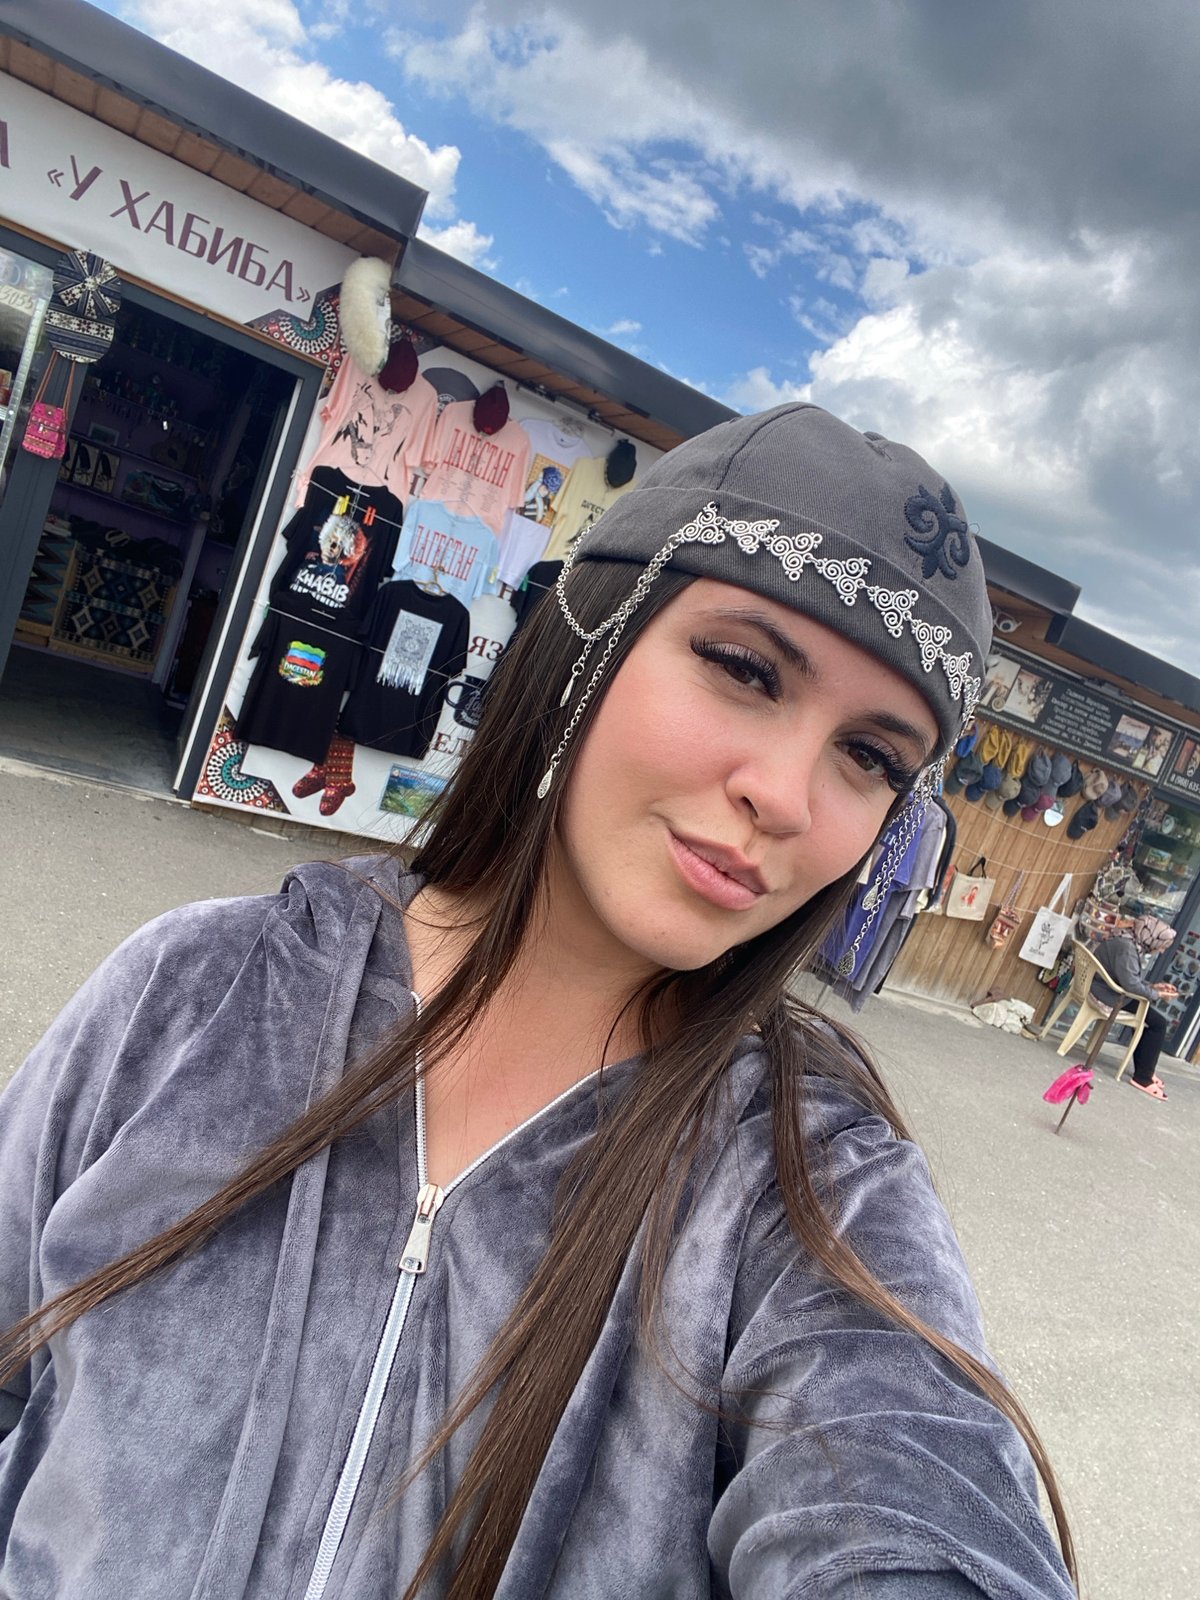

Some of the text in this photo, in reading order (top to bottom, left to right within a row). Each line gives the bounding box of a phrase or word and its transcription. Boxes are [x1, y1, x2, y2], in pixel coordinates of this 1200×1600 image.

[47, 154, 311, 303] «У ХАБИБА»
[441, 428, 515, 488] ДАГЕСТАН
[410, 523, 479, 581] ДАГЕСТАН
[295, 568, 350, 602] KHABIB
